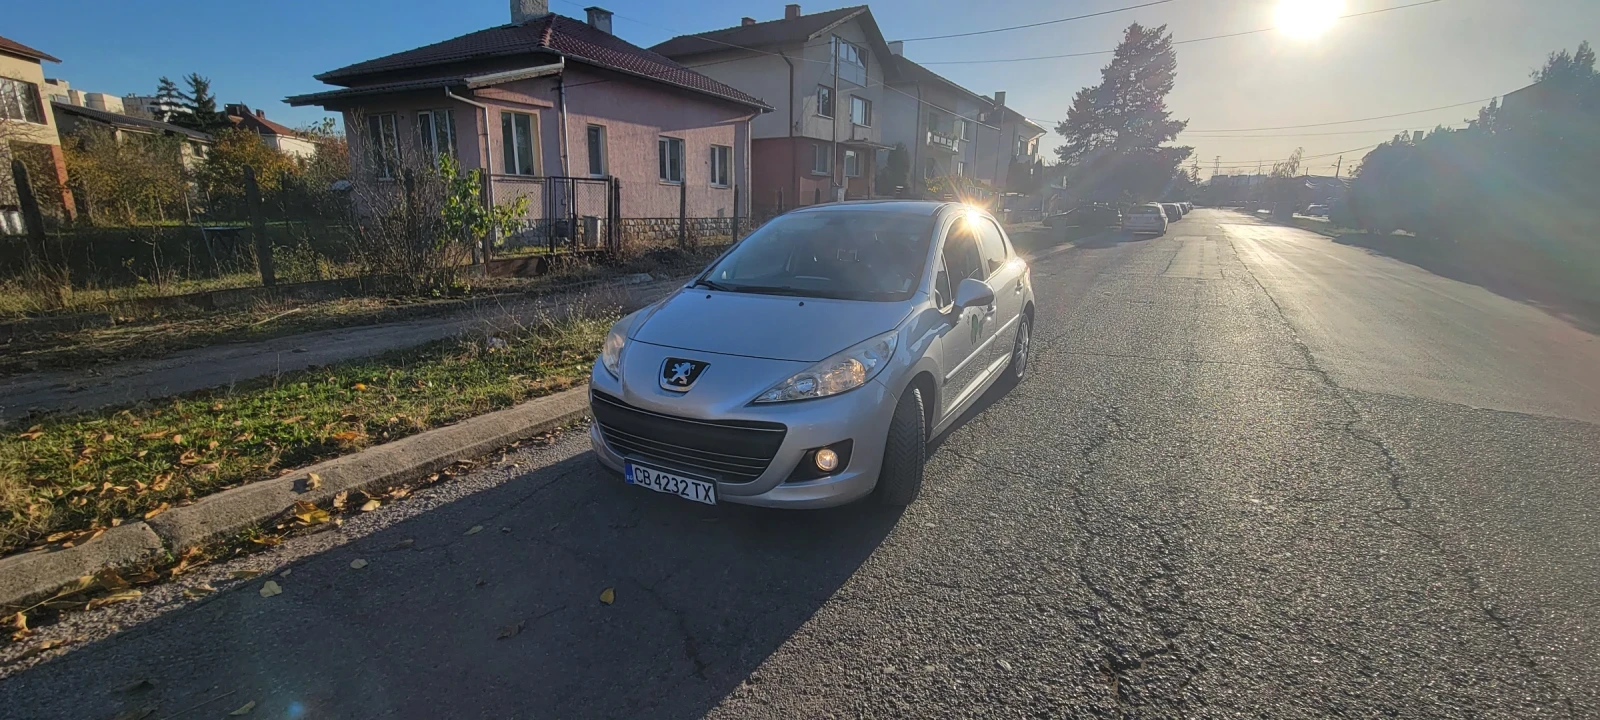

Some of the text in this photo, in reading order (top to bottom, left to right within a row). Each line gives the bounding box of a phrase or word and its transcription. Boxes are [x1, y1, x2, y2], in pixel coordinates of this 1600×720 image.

[634, 467, 713, 503] CB 4232 TX
